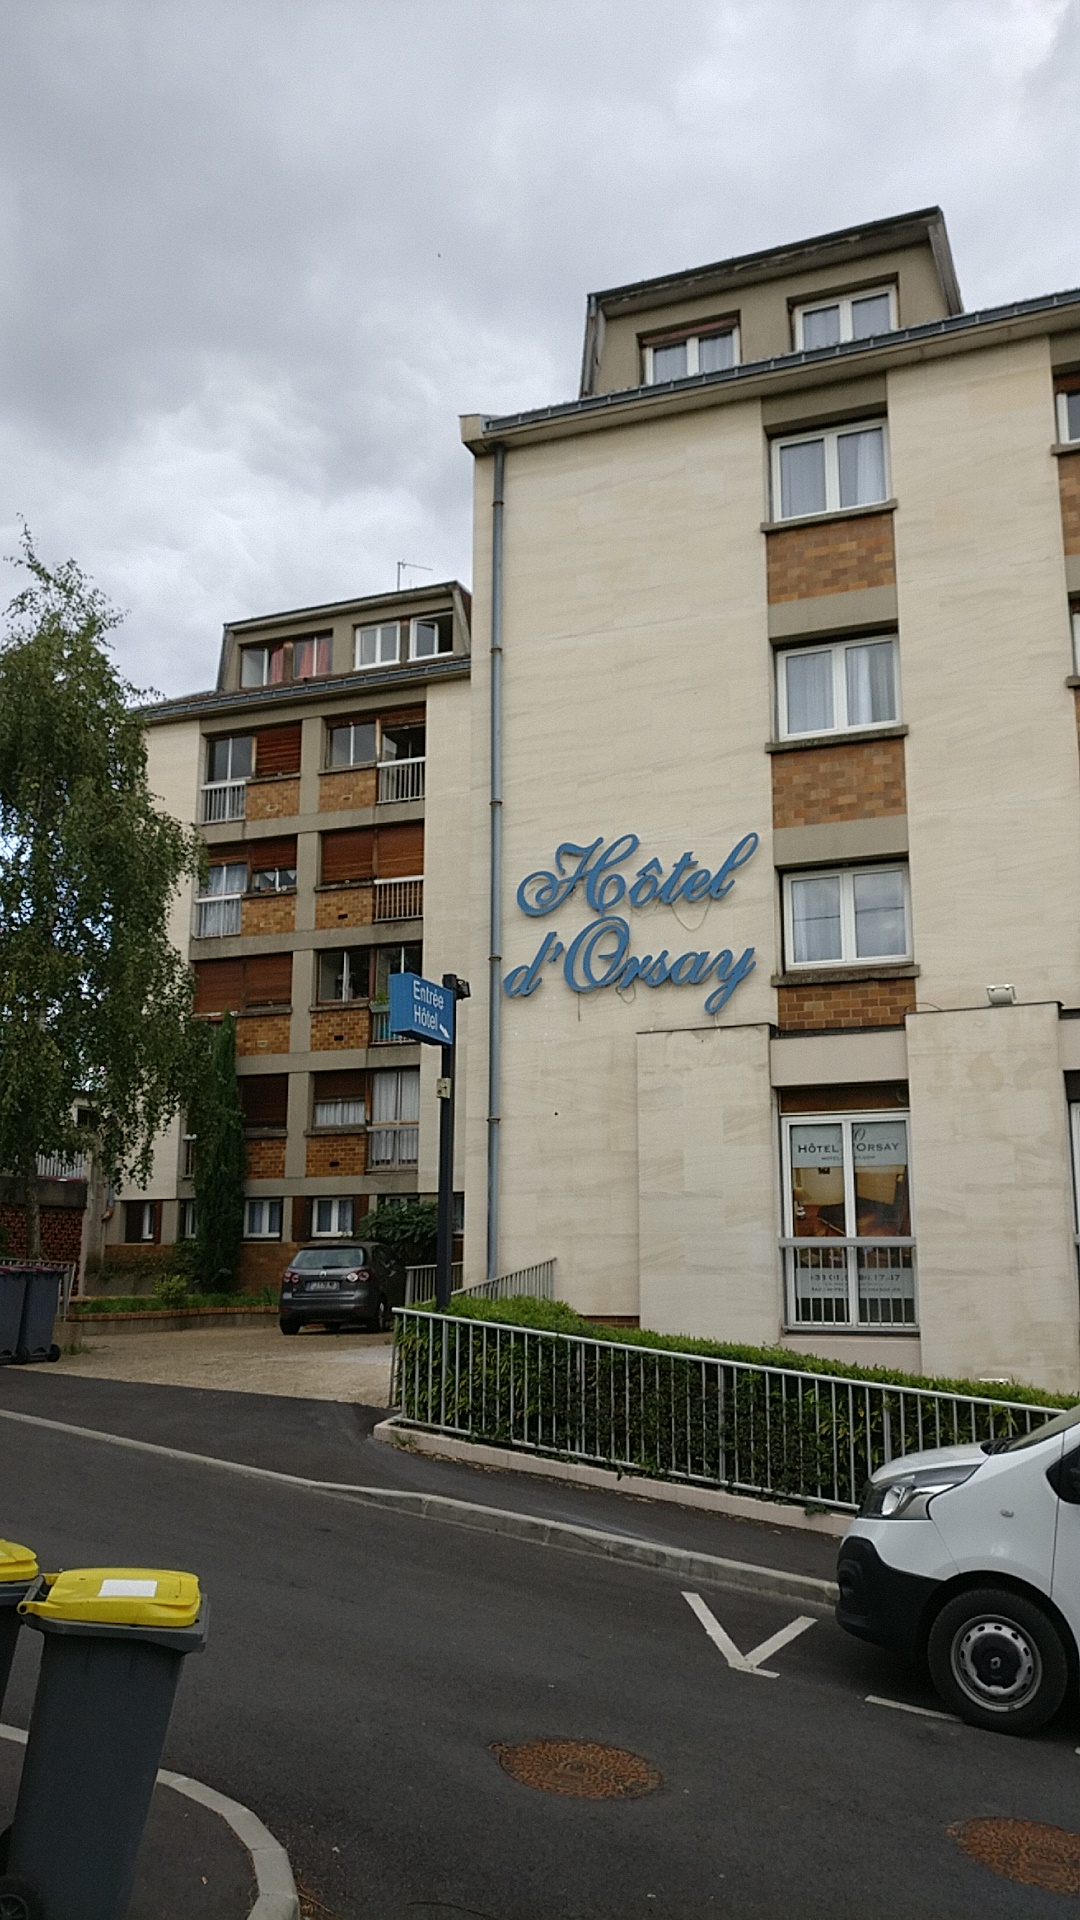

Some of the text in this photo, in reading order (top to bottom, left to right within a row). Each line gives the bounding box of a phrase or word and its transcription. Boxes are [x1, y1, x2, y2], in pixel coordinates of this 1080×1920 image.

[516, 832, 759, 917] Hôtel
[502, 915, 757, 1015] d'Orsay
[413, 980, 444, 1010] Entrée
[414, 1004, 438, 1031] Hôtel
[797, 1142, 839, 1153] HÔTEL
